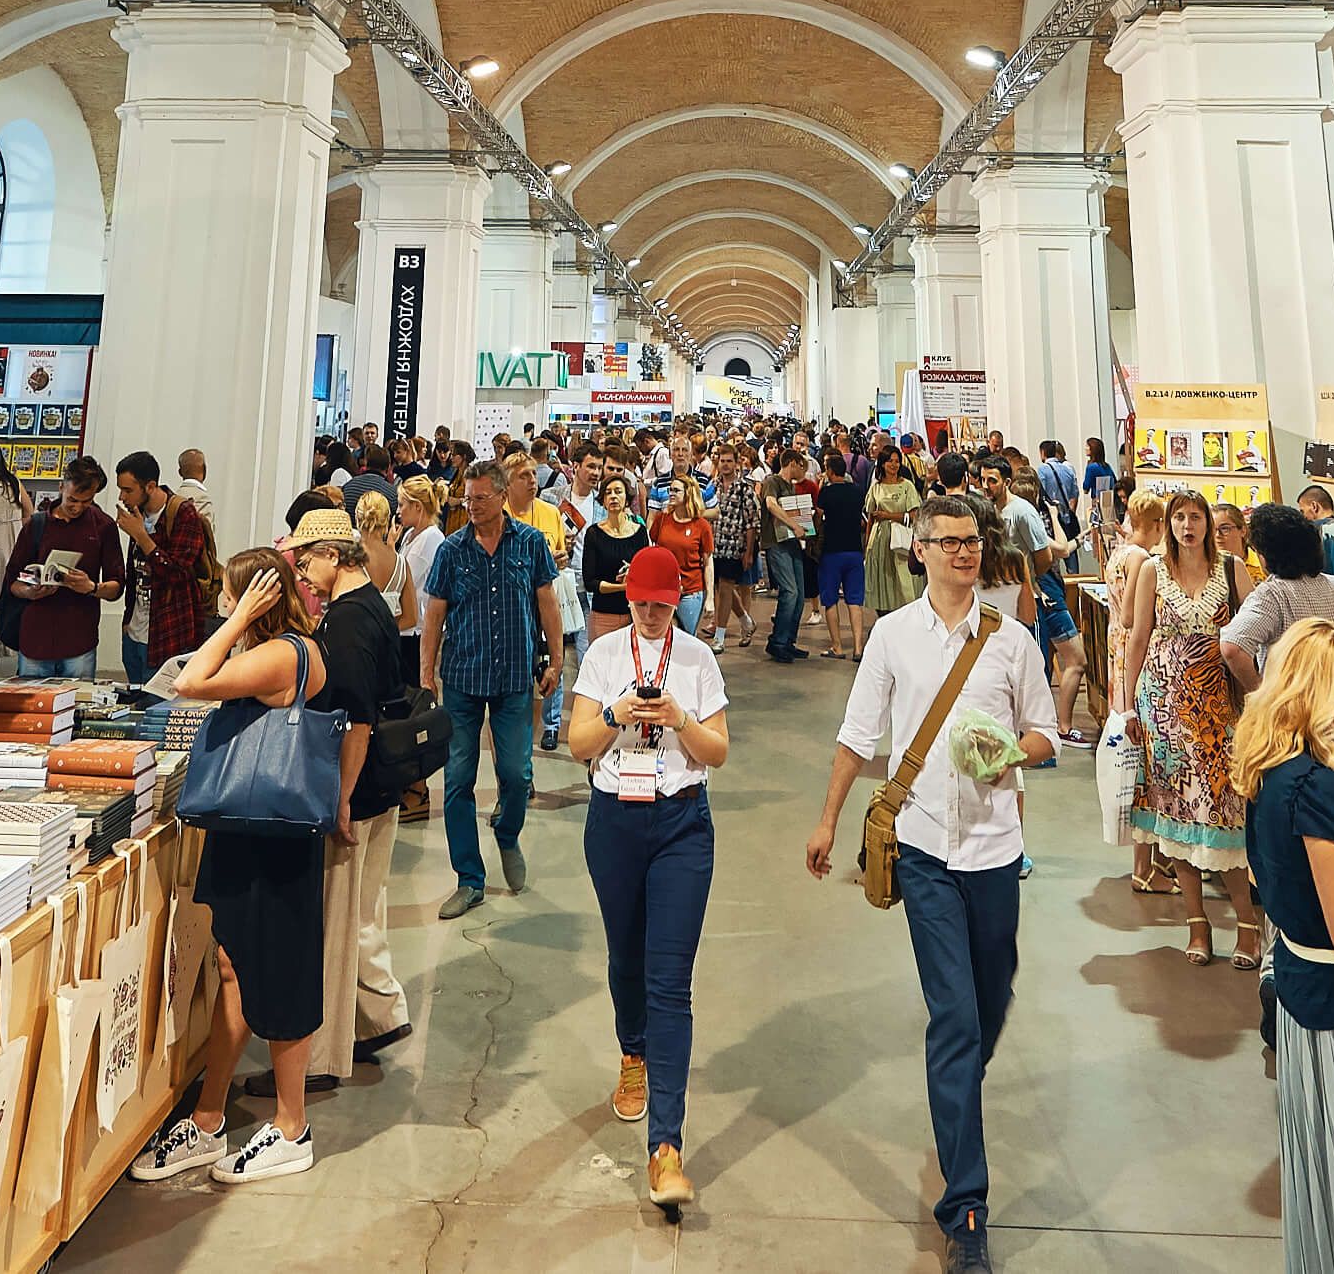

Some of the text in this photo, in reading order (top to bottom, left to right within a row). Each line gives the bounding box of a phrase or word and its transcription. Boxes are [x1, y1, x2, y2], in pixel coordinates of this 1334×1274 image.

[396, 284, 415, 371] ХУДОЖНЯ
[922, 373, 956, 382] РОЗКЛАД
[1175, 390, 1258, 399] ДОВЖЕНКО-ЦЕНТР
